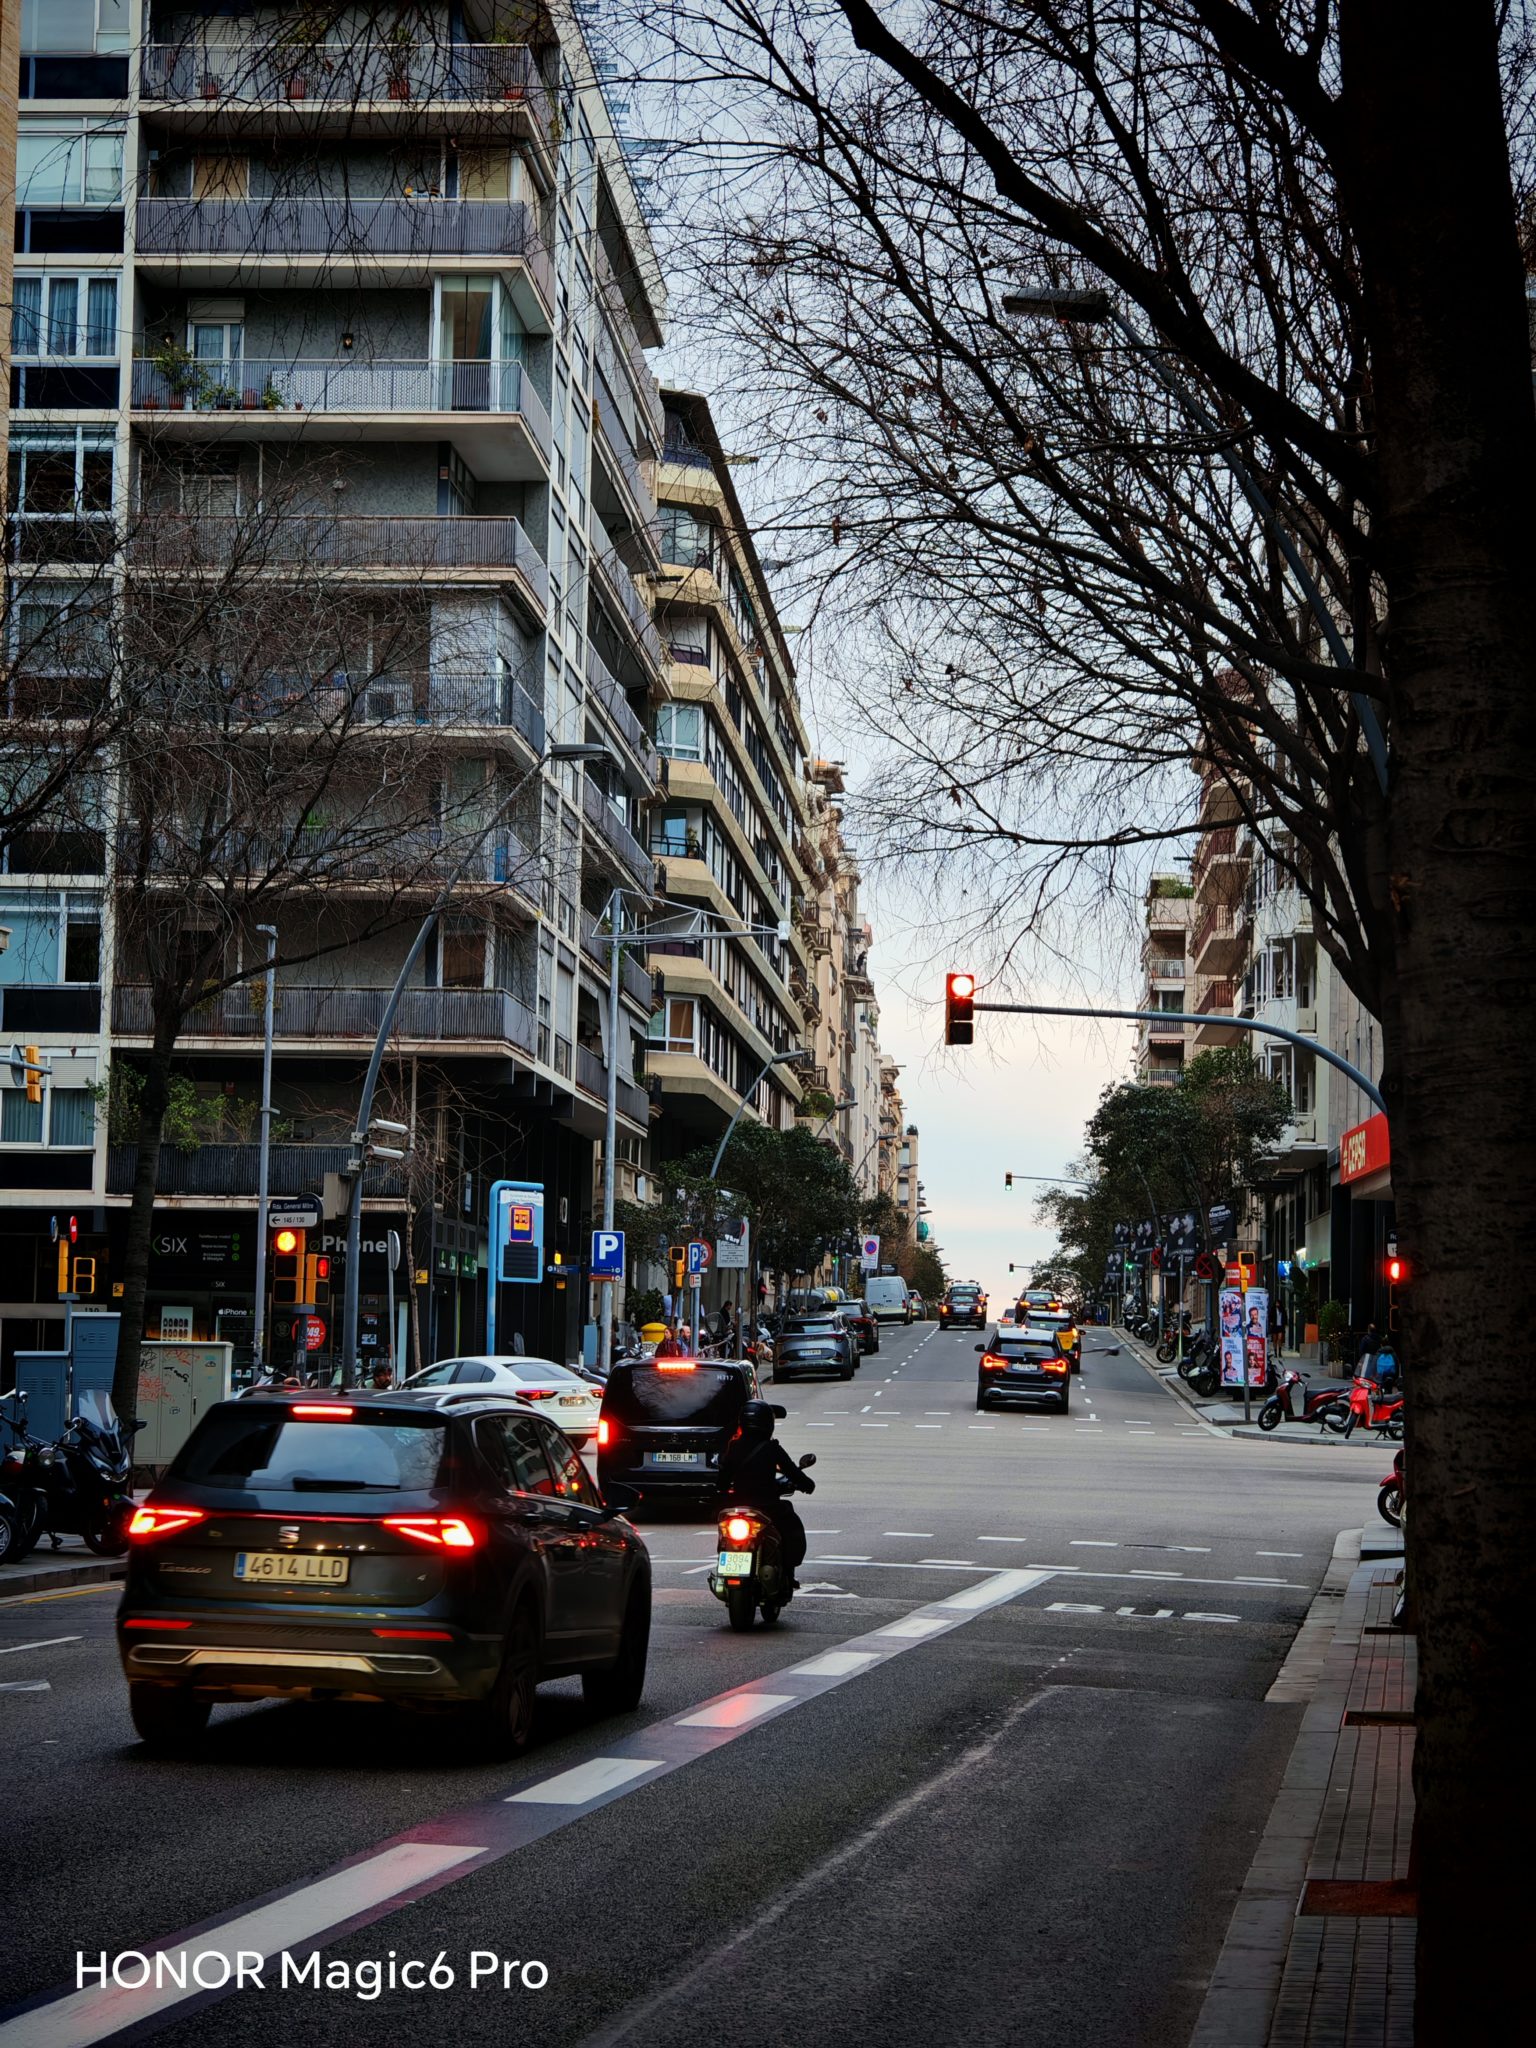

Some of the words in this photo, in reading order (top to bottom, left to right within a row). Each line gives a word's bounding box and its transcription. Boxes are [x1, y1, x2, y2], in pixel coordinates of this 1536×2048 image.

[1348, 1130, 1366, 1175] CEPSA
[283, 1202, 301, 1210] General
[599, 1234, 619, 1260] P
[223, 1308, 247, 1316] iPhone
[249, 1556, 298, 1576] 4614
[305, 1559, 344, 1578] LLD
[727, 1553, 750, 1563] 3094
[1043, 1602, 1242, 1623] BUS
